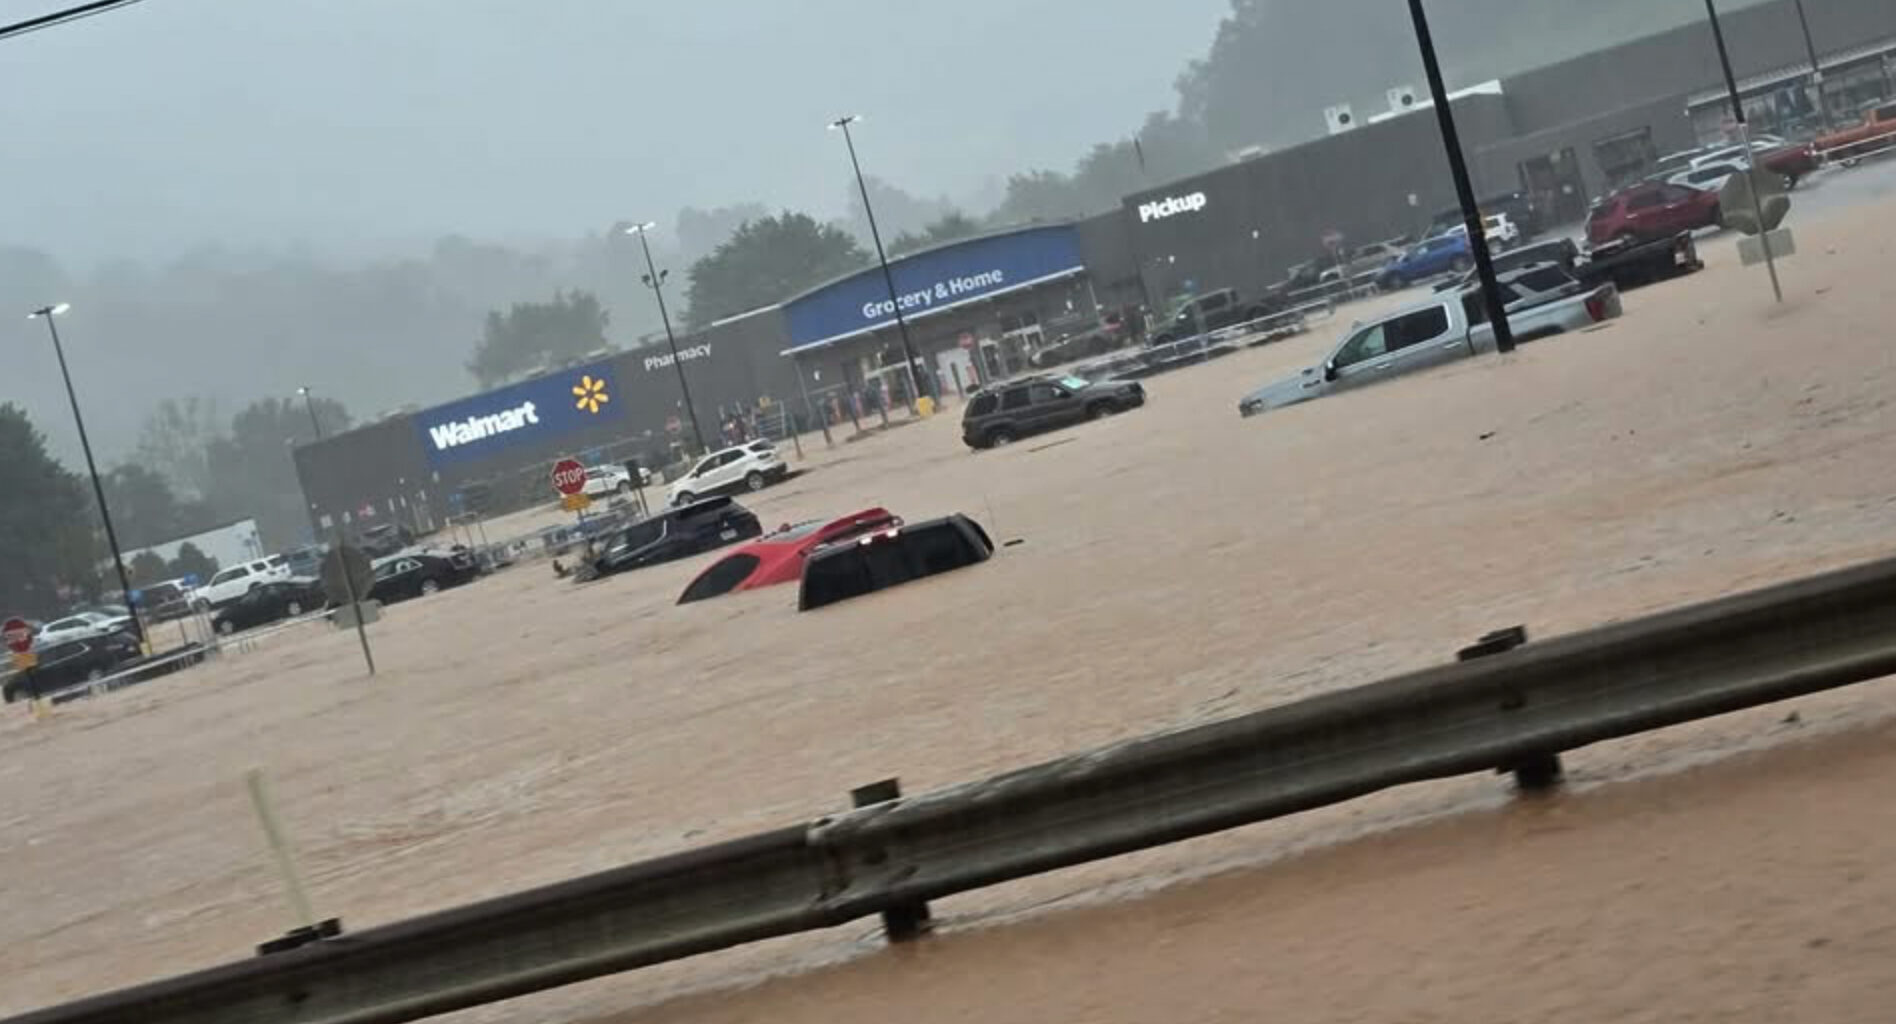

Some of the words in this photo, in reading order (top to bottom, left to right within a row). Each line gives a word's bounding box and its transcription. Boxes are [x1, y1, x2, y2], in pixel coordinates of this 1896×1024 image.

[1138, 192, 1206, 223] Pickup
[934, 282, 949, 299] &
[949, 269, 1003, 295] Home
[644, 342, 711, 371] Pharmacy
[429, 401, 539, 450] Walmart
[555, 467, 583, 487] STOP
